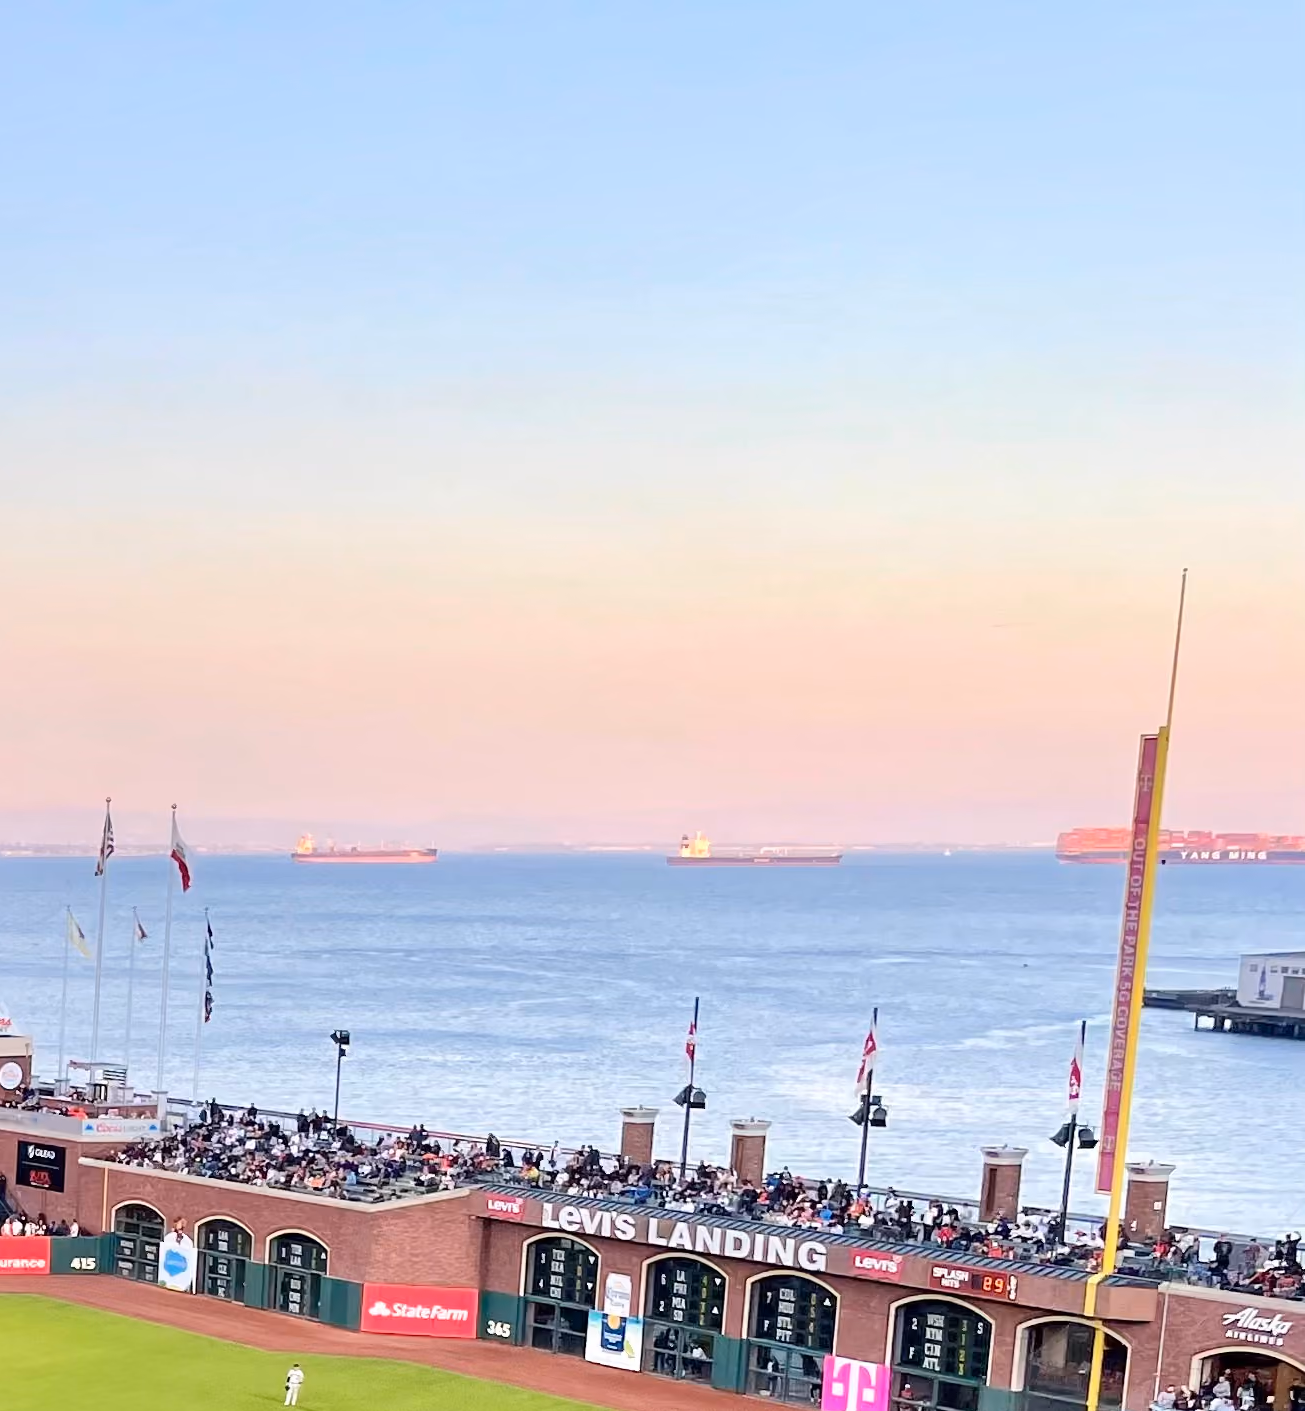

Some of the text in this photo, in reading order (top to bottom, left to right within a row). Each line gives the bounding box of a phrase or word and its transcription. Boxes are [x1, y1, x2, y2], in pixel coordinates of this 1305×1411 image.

[1180, 851, 1268, 860] YANG MING
[1125, 899, 1141, 934] THE
[1119, 935, 1136, 977] PARK
[1109, 1006, 1130, 1092] COVERAGE
[647, 1217, 828, 1273] LANDING
[71, 1257, 96, 1270] 415
[932, 1266, 970, 1282] SPLASH
[941, 1278, 961, 1289] HITS
[982, 1275, 1004, 1293] 89
[391, 1302, 469, 1321] State Farm
[487, 1320, 511, 1338] 365
[1221, 1307, 1294, 1336] Alaska
[1225, 1329, 1284, 1347] AIRLINES
[922, 1357, 941, 1371] ATL
